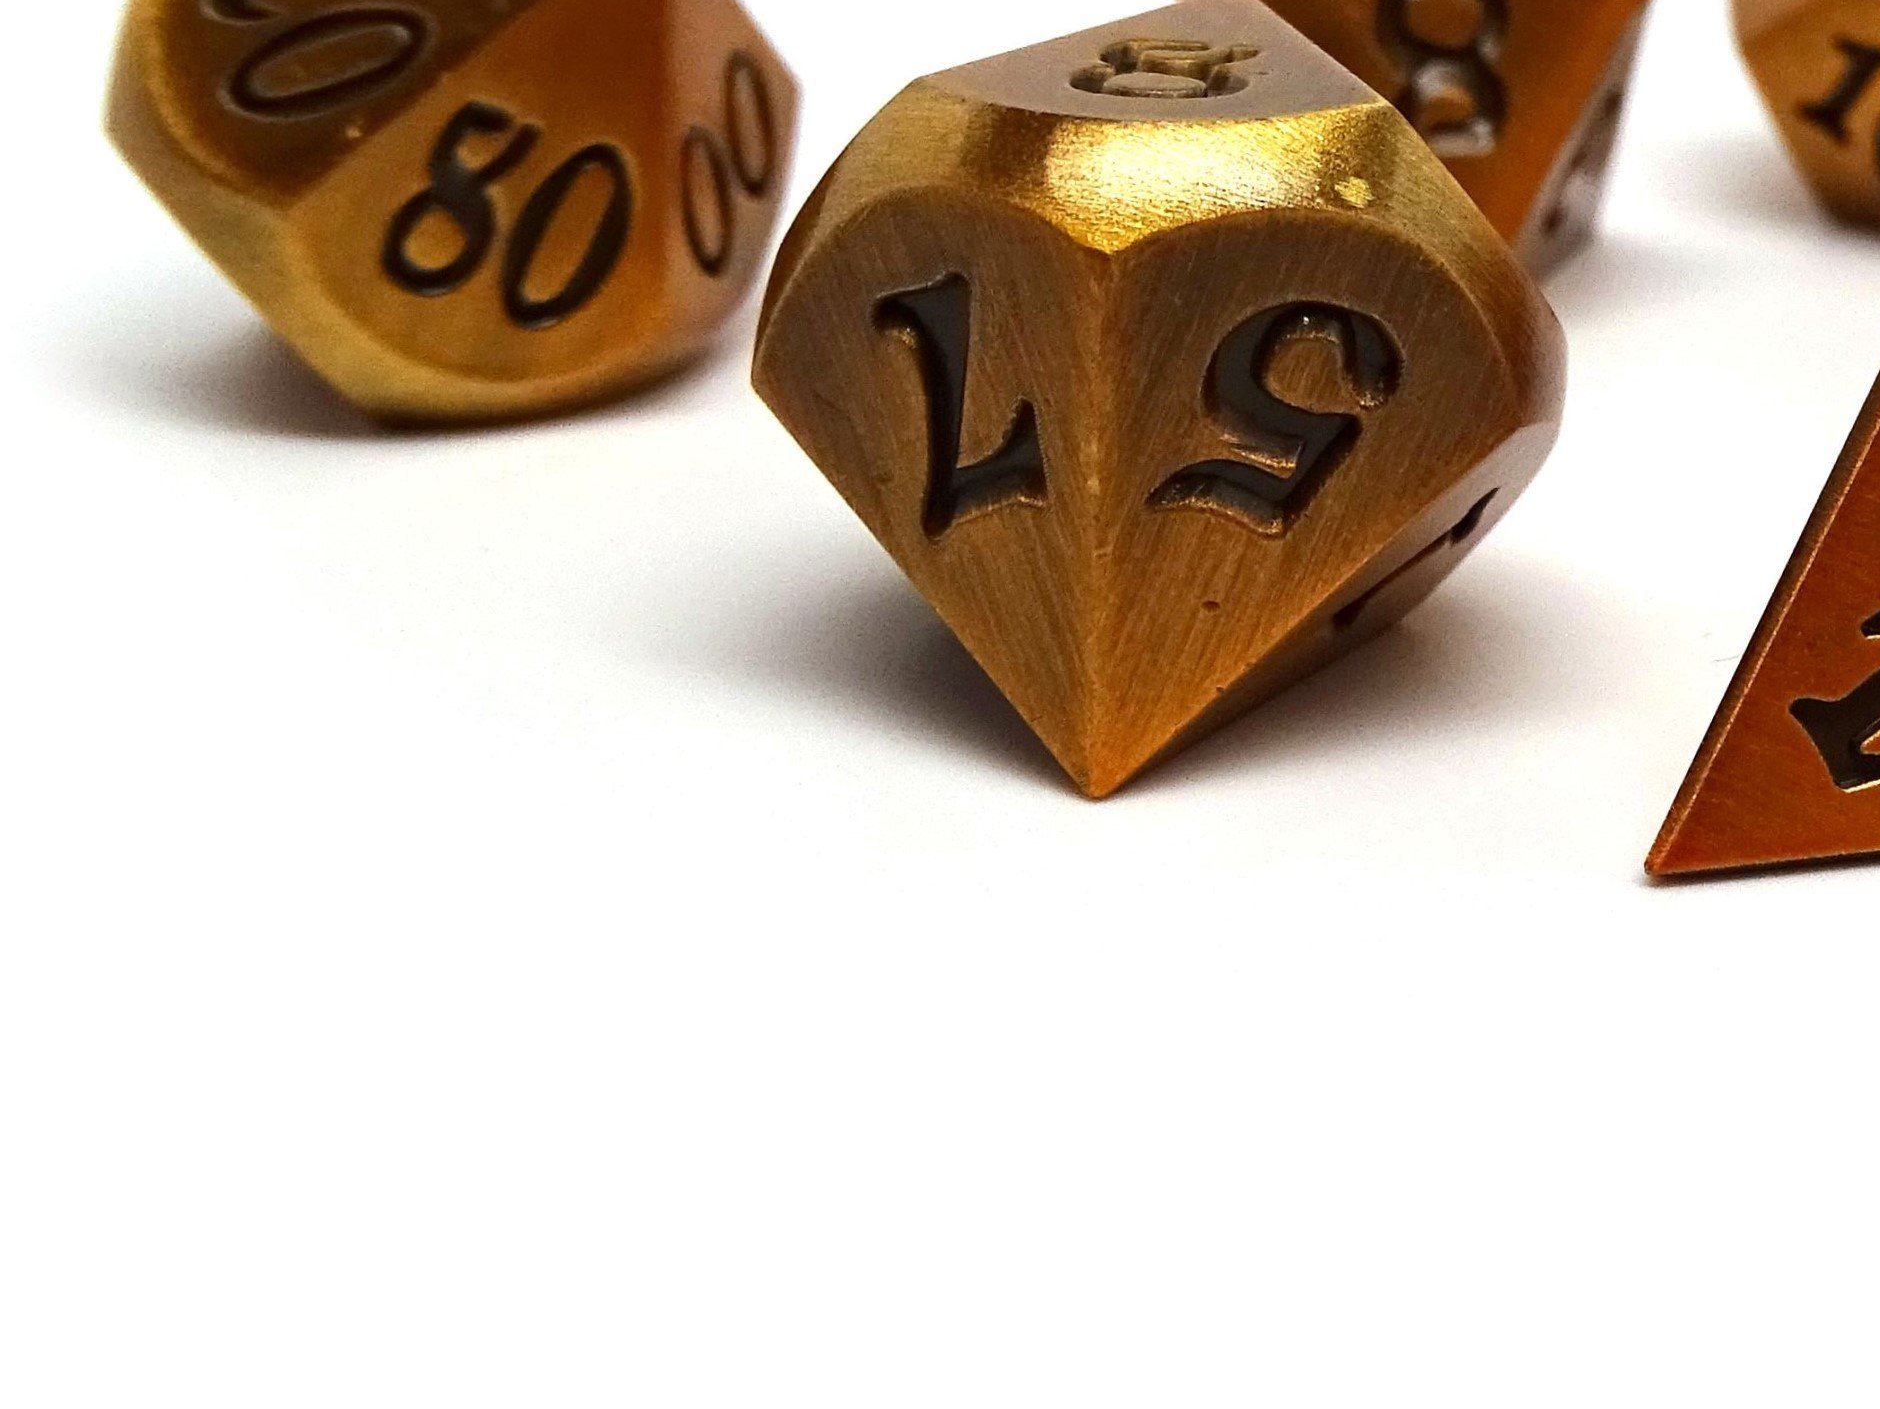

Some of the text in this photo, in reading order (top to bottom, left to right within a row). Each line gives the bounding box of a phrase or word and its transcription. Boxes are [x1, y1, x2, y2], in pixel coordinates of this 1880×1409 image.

[382, 101, 634, 328] 80
[681, 51, 776, 277] 00
[872, 272, 1051, 539] 7
[1147, 299, 1403, 539] 5
